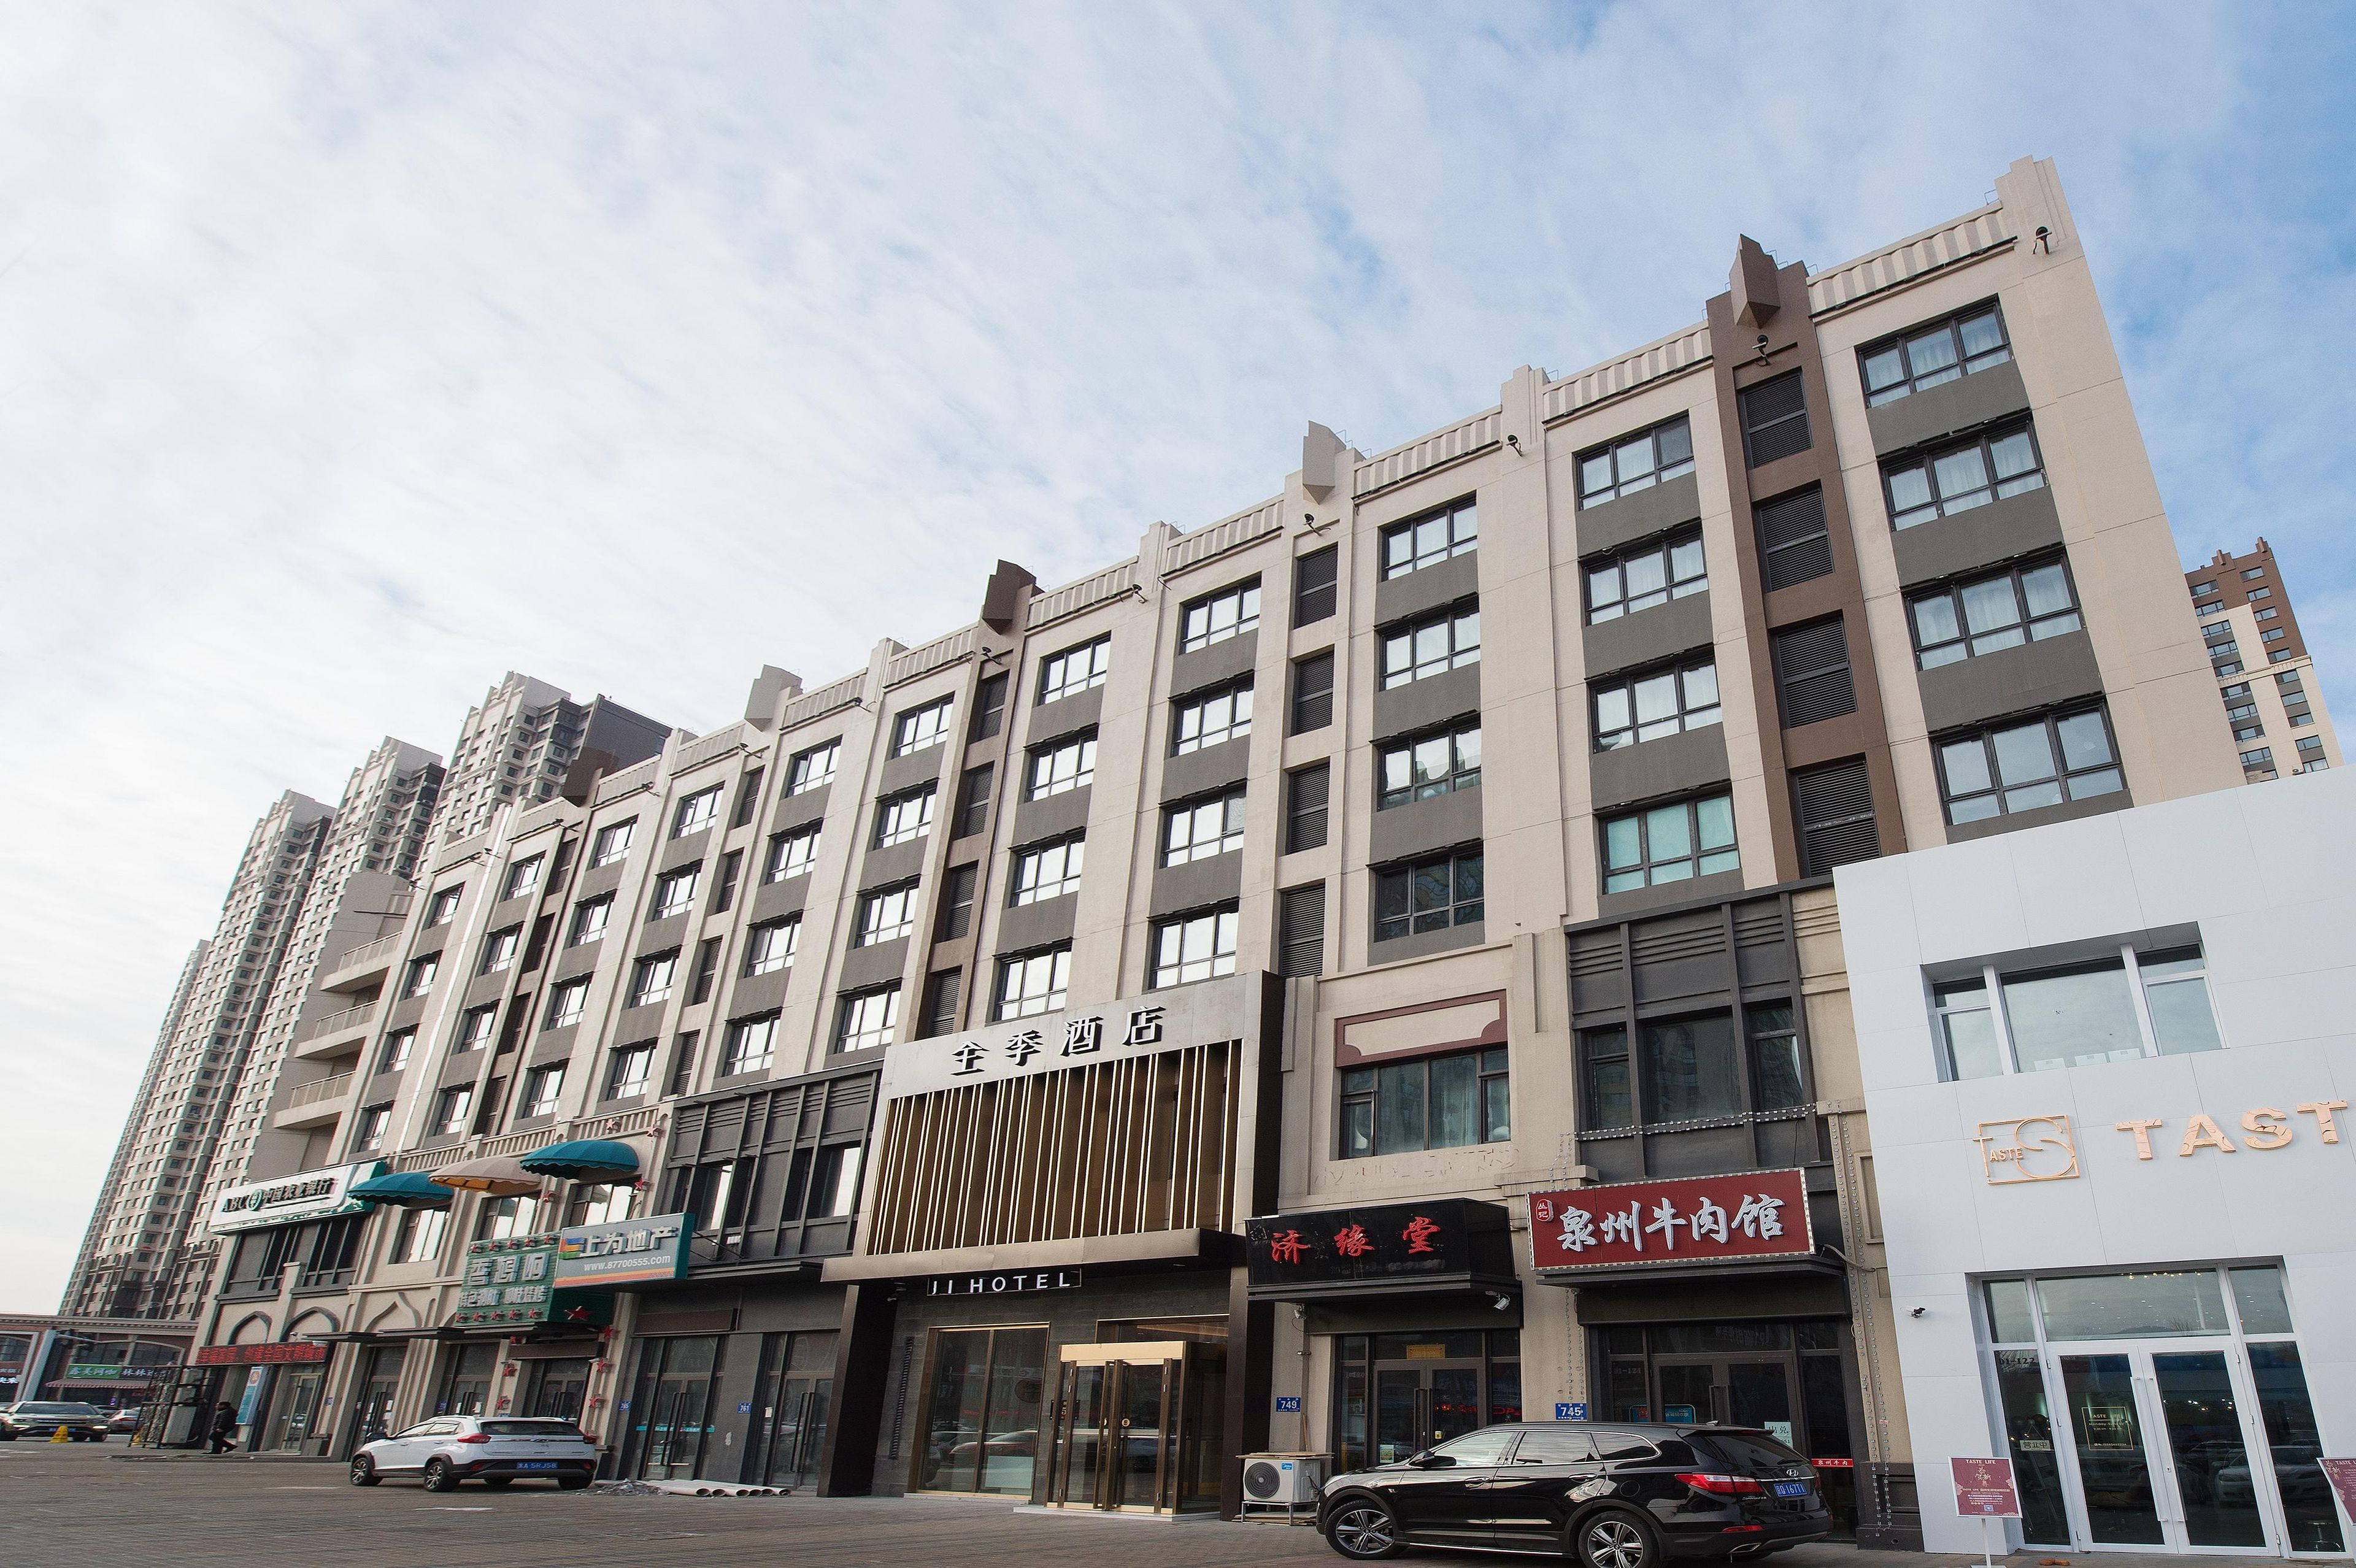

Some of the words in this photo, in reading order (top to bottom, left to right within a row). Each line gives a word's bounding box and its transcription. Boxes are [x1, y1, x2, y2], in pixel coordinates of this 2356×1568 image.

[950, 1005, 1166, 1076] 全季酒店
[2115, 1099, 2347, 1161] TAST
[1271, 1216, 1441, 1266] 济缘堂
[1556, 1193, 1785, 1253] 泉州牛肉馆
[583, 1255, 671, 1272] www.87700555.com
[932, 1280, 953, 1295] JI
[969, 1272, 1071, 1294] HOTEL
[1280, 1401, 1297, 1409] 749
[1560, 1407, 1581, 1416] 745
